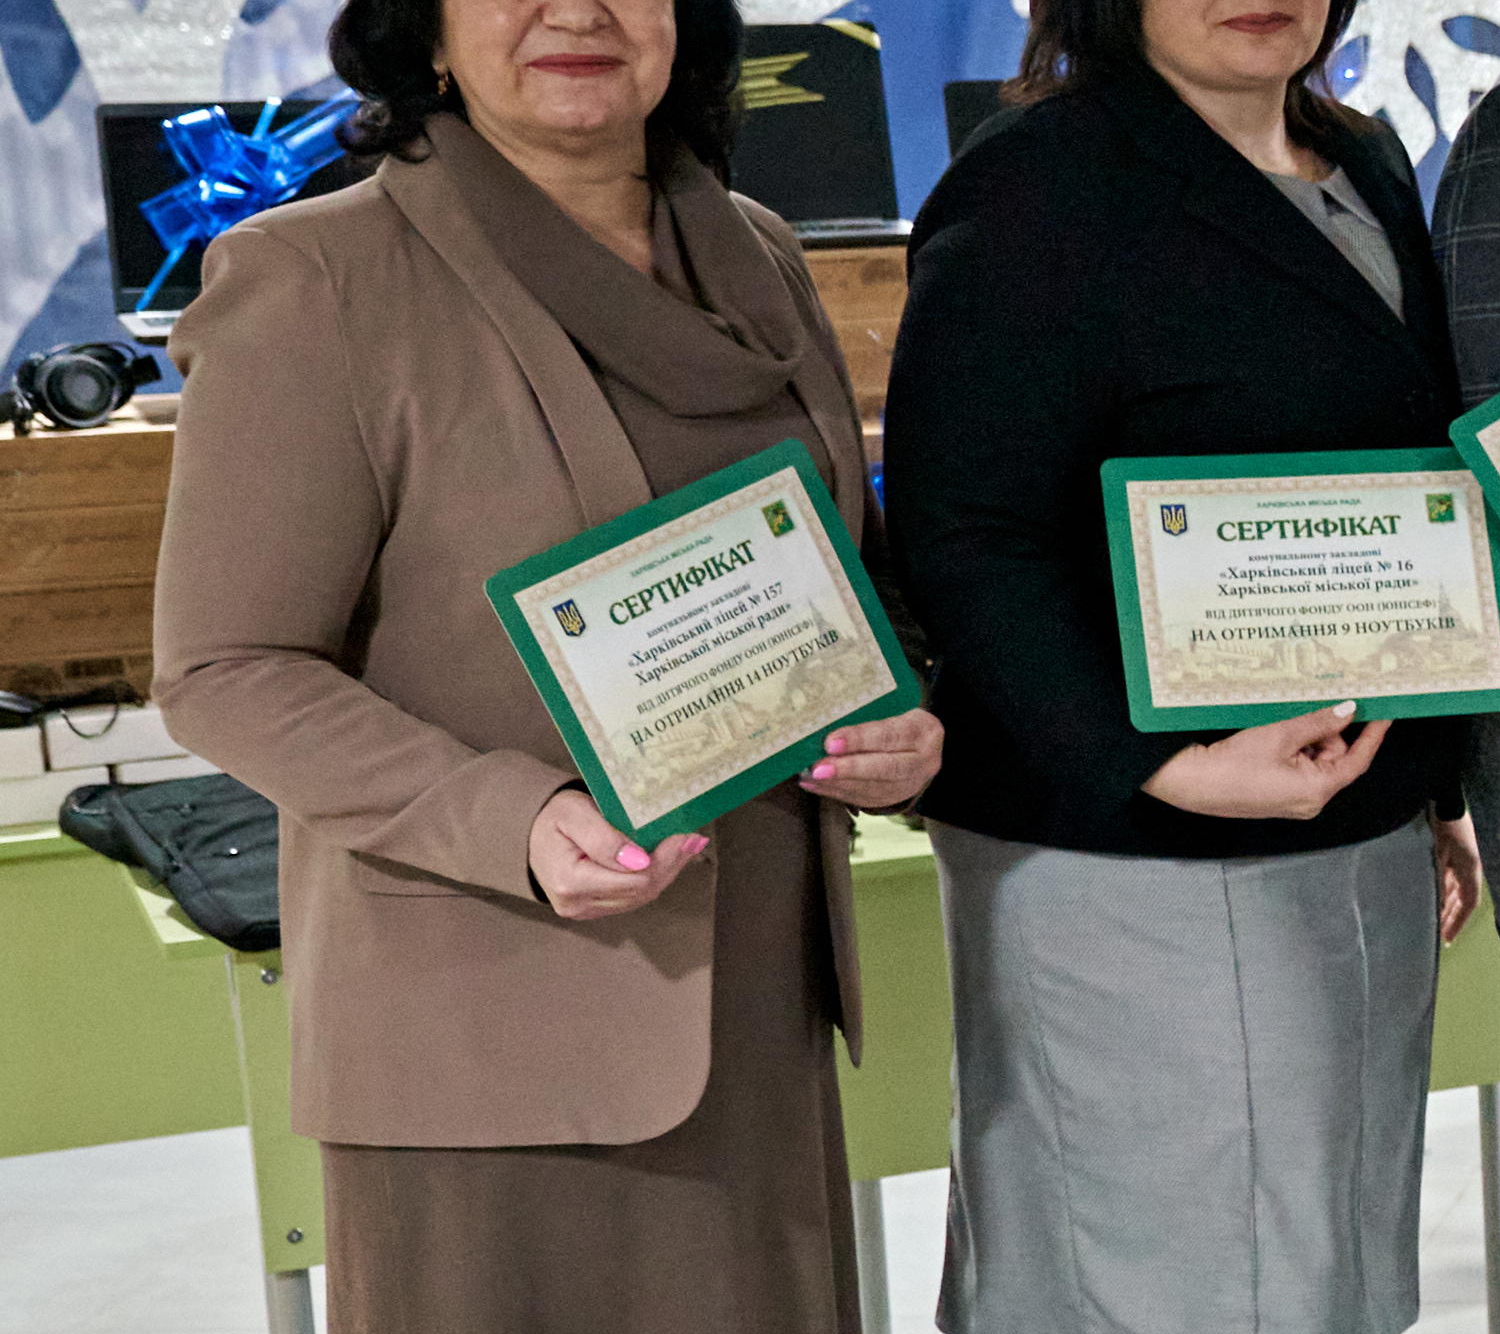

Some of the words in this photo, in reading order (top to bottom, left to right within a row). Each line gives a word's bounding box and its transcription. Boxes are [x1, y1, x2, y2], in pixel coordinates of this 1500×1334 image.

[1216, 515, 1401, 542] СЕРТИФІКАТ
[608, 539, 756, 626] СЕРТИФІКАТ
[1217, 580, 1311, 599] Харківської
[1315, 577, 1370, 592] міської
[1375, 578, 1419, 592] ради»
[1219, 564, 1327, 582] «Харківський
[1331, 561, 1373, 576] ліцей
[627, 618, 714, 669] «Харківський
[713, 600, 748, 627] ліцей
[762, 581, 783, 601] 157
[1205, 609, 1226, 620] ВІД
[1298, 604, 1343, 615] ФОНДУ
[1346, 602, 1374, 612] ООН
[1221, 623, 1337, 640] ОТРИМАННЯ
[1355, 616, 1455, 634] НОУТБУКІВ
[634, 638, 711, 687] Харківської
[710, 616, 757, 648] міської
[756, 602, 792, 629] ради»
[629, 725, 654, 746] НА
[653, 677, 745, 733] ОТРИМАННЯ
[745, 669, 762, 686] 14
[760, 629, 839, 678] НОУТБУКІВ
[636, 698, 656, 715] ВІД
[708, 652, 744, 678] ФОНДУ
[743, 641, 768, 660] ООН
